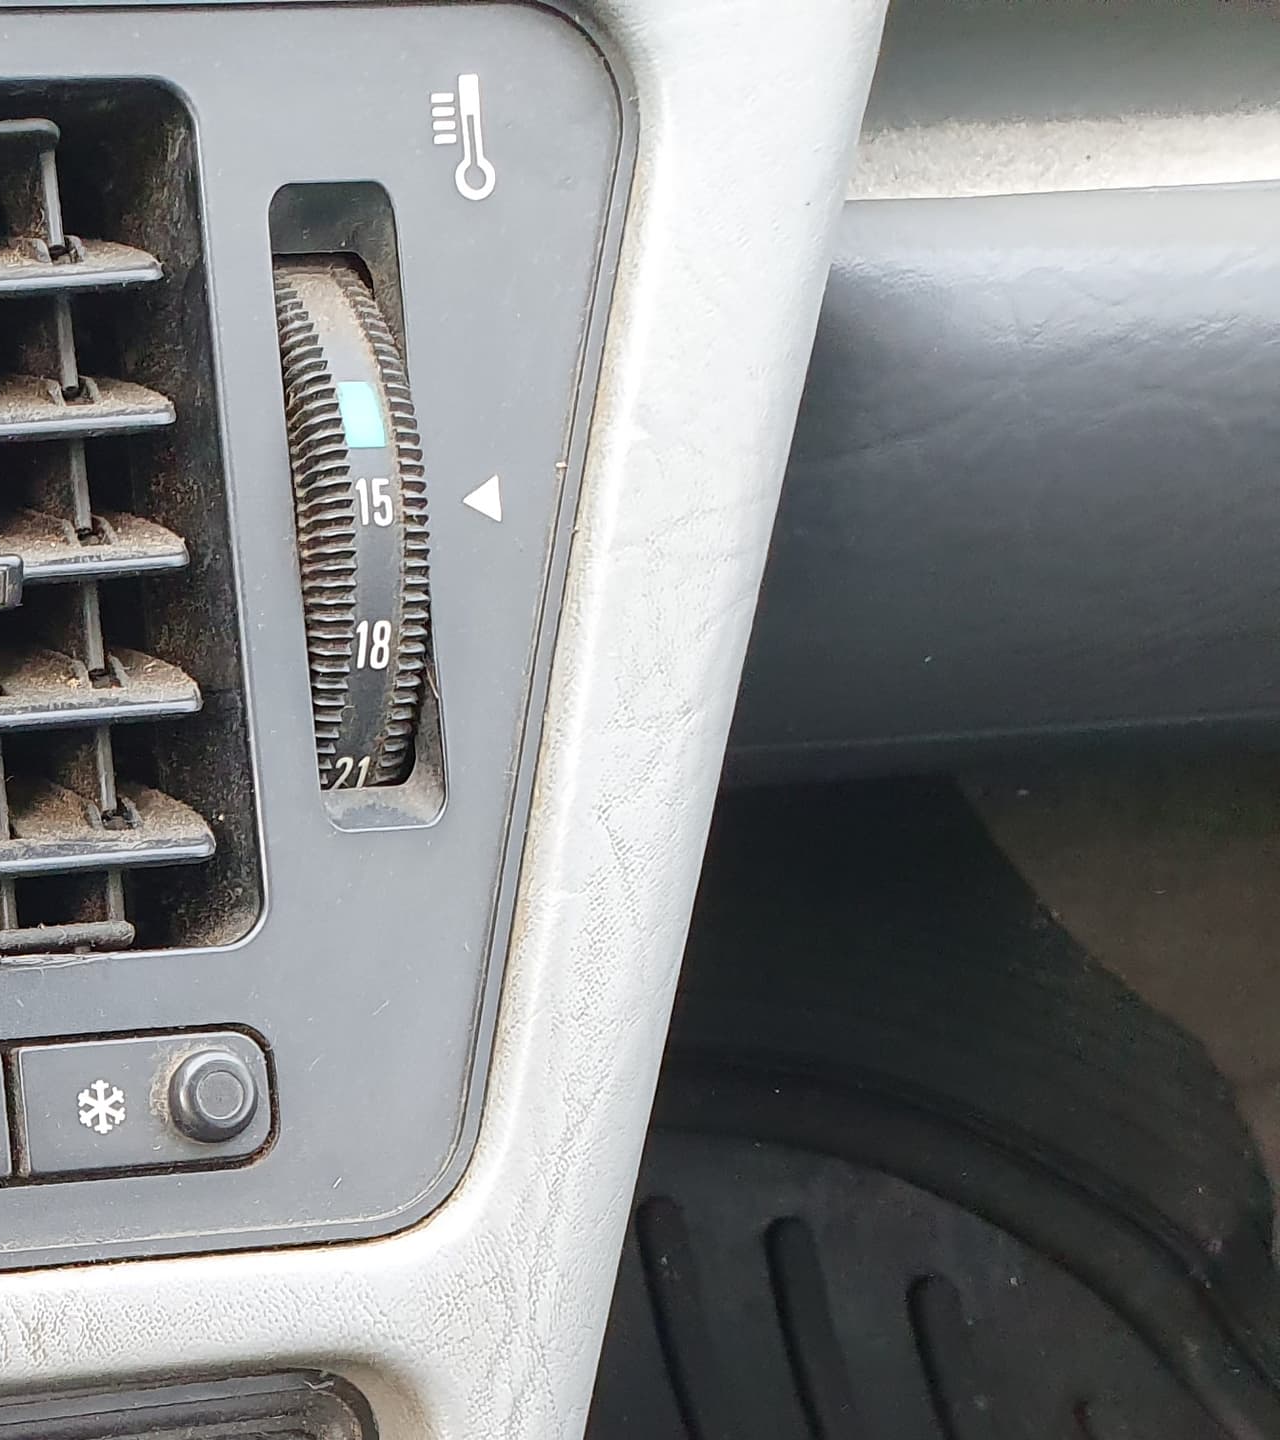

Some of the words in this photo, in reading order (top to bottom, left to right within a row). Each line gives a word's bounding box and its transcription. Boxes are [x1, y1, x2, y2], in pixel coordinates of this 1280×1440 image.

[355, 478, 393, 527] 15
[355, 620, 392, 670] 18
[332, 756, 371, 789] 21
